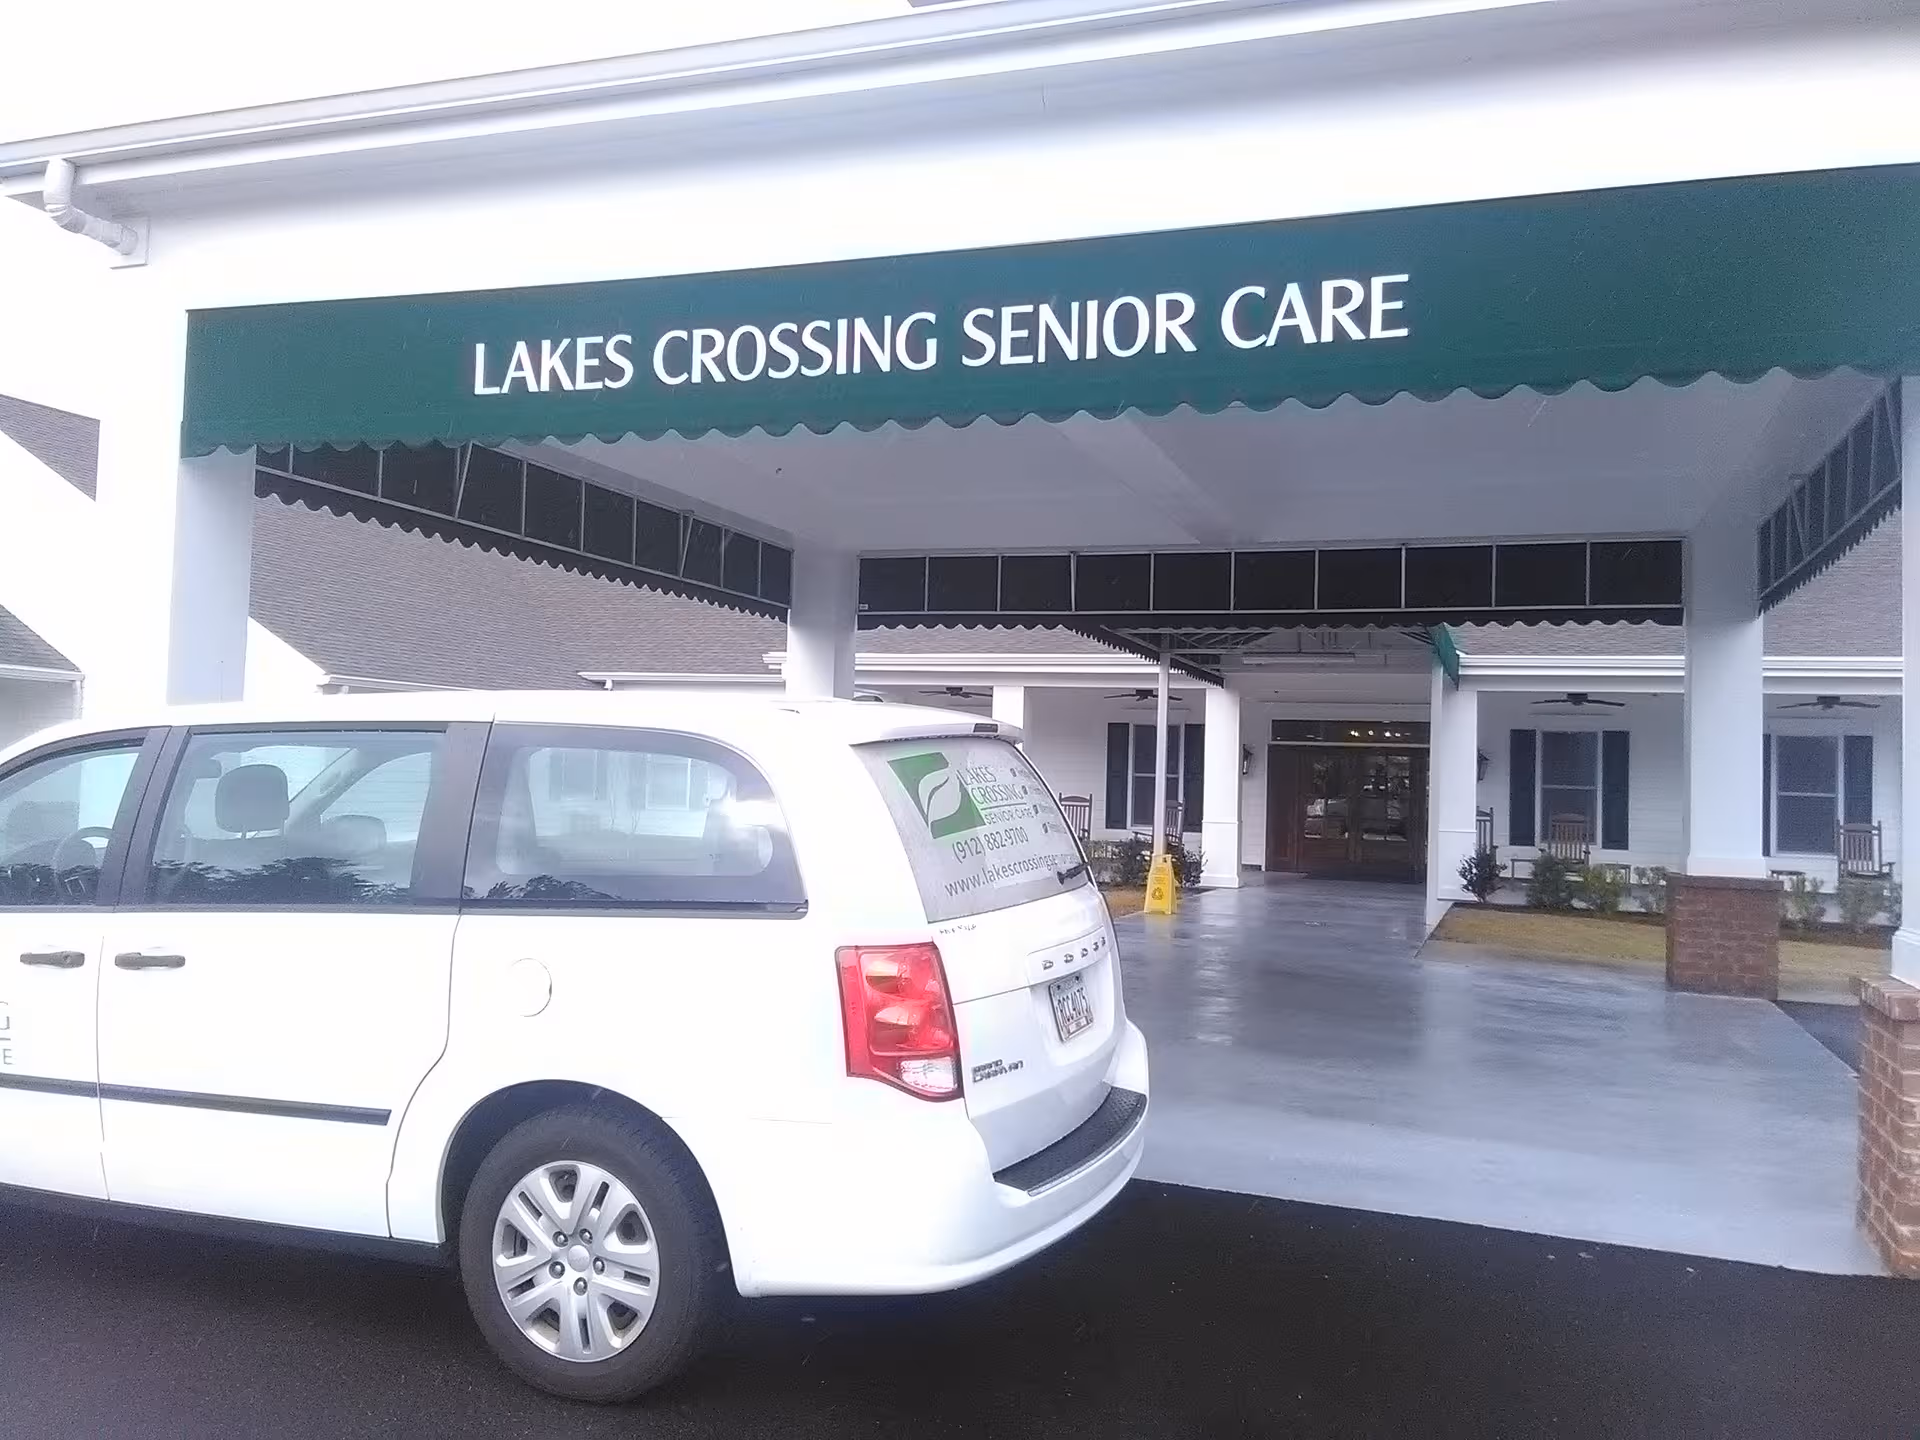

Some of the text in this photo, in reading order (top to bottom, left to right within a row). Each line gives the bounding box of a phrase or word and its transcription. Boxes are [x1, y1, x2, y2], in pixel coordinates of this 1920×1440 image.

[474, 274, 1409, 396] LAKES CROSSING SENIOR CARE
[956, 766, 997, 786] LAKES
[970, 784, 1023, 804] CROSSING
[984, 809, 1014, 825] SENIOR
[952, 836, 985, 864] (912)
[986, 827, 1030, 851] 882-9700
